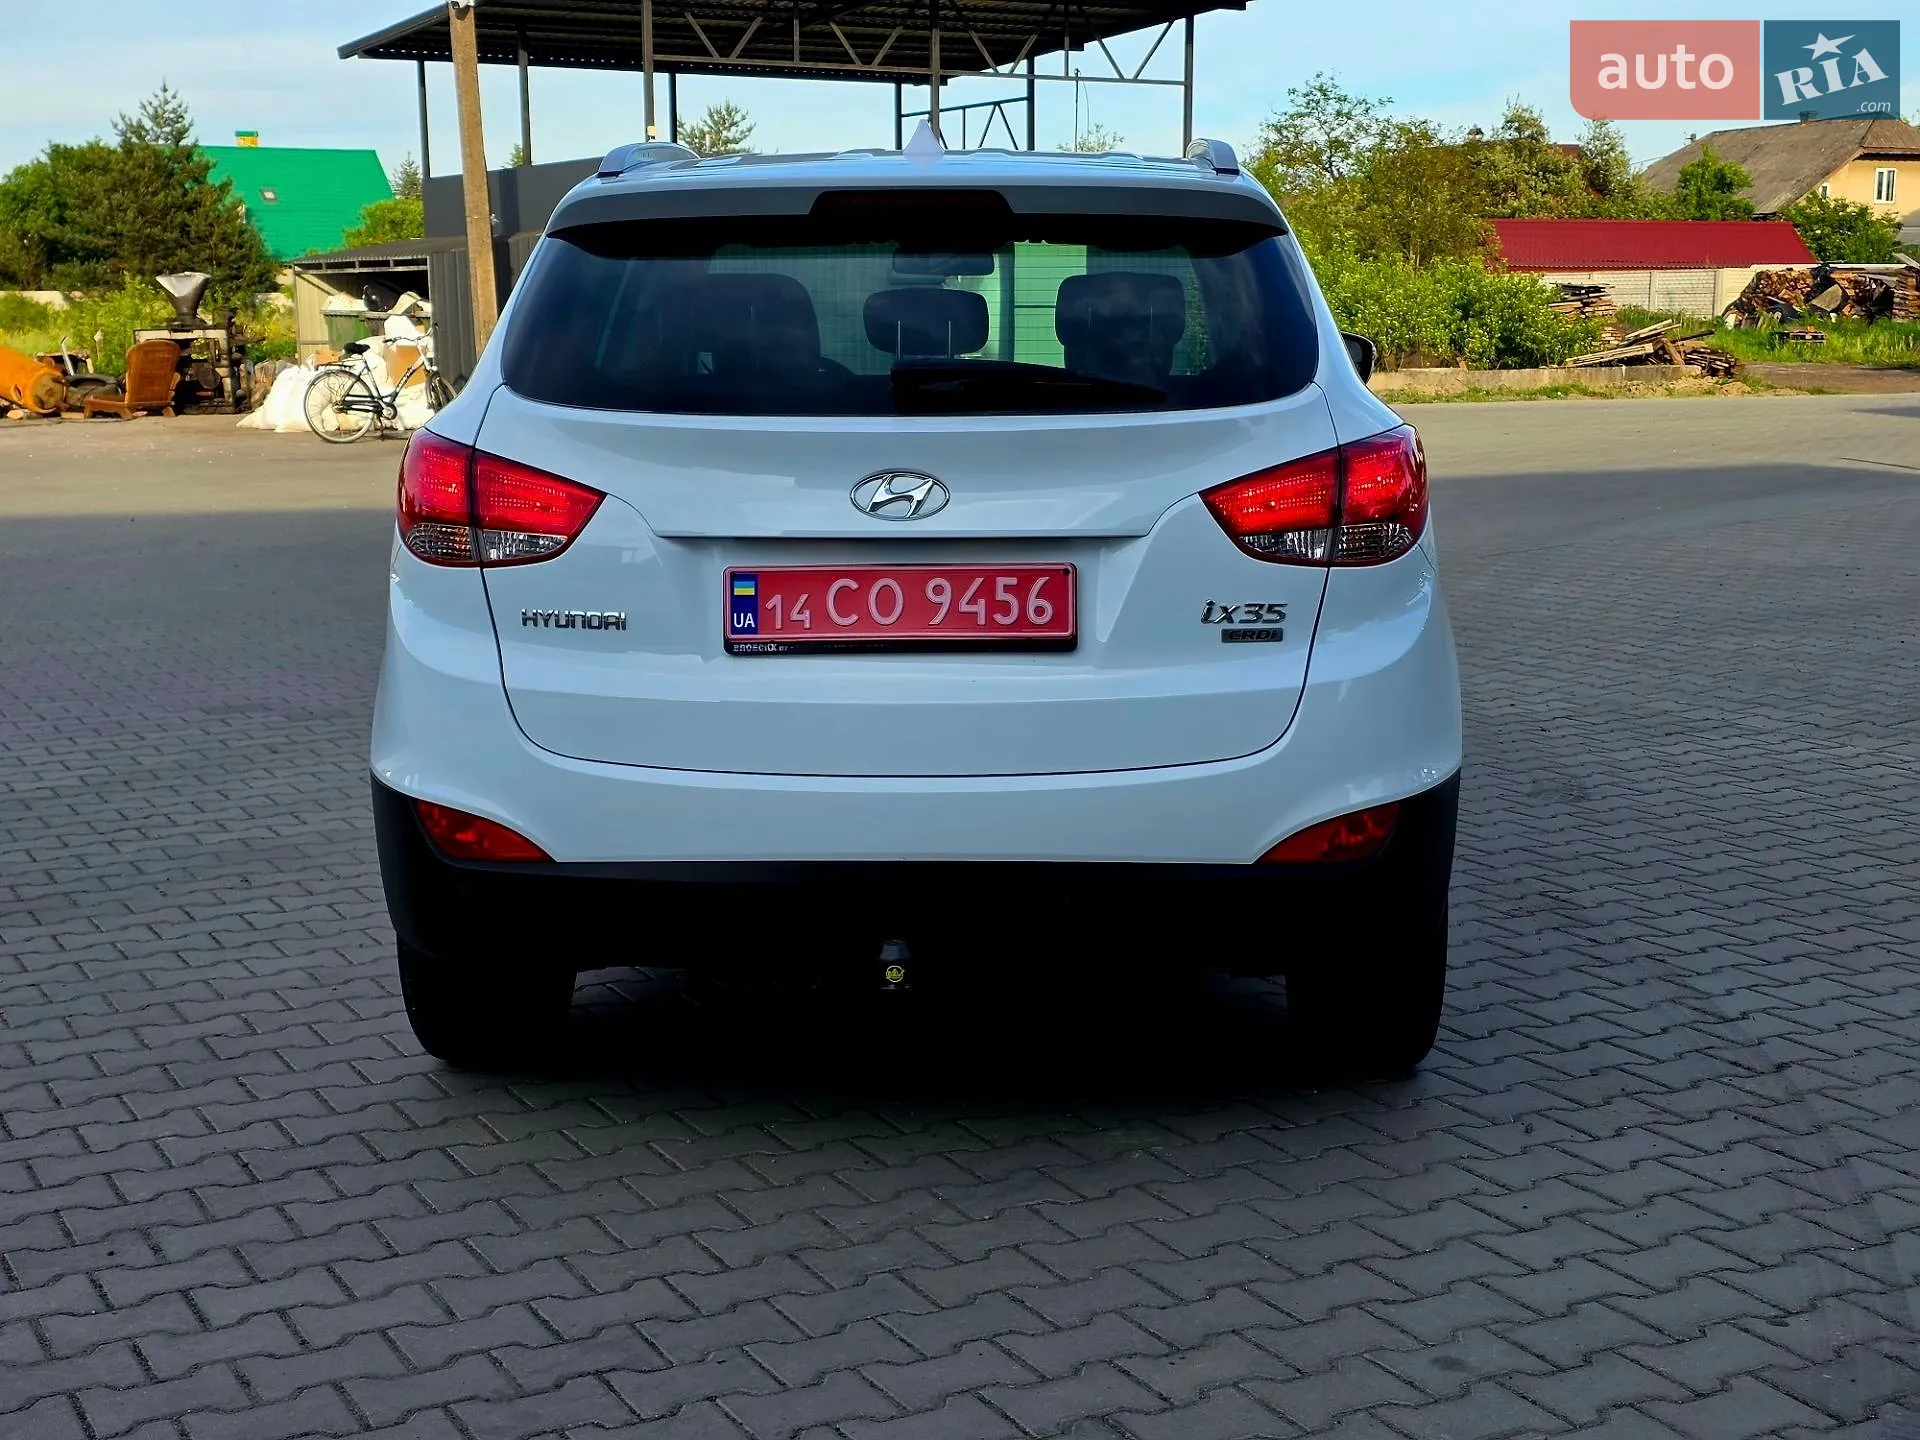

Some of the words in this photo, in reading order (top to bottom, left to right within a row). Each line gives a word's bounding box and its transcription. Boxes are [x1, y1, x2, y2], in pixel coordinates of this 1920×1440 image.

[765, 593, 812, 630] 14
[826, 577, 905, 627] CO
[925, 576, 1054, 627] 9456
[1200, 599, 1288, 624] ix35
[521, 608, 627, 631] HYUNDAI
[733, 612, 756, 628] UA
